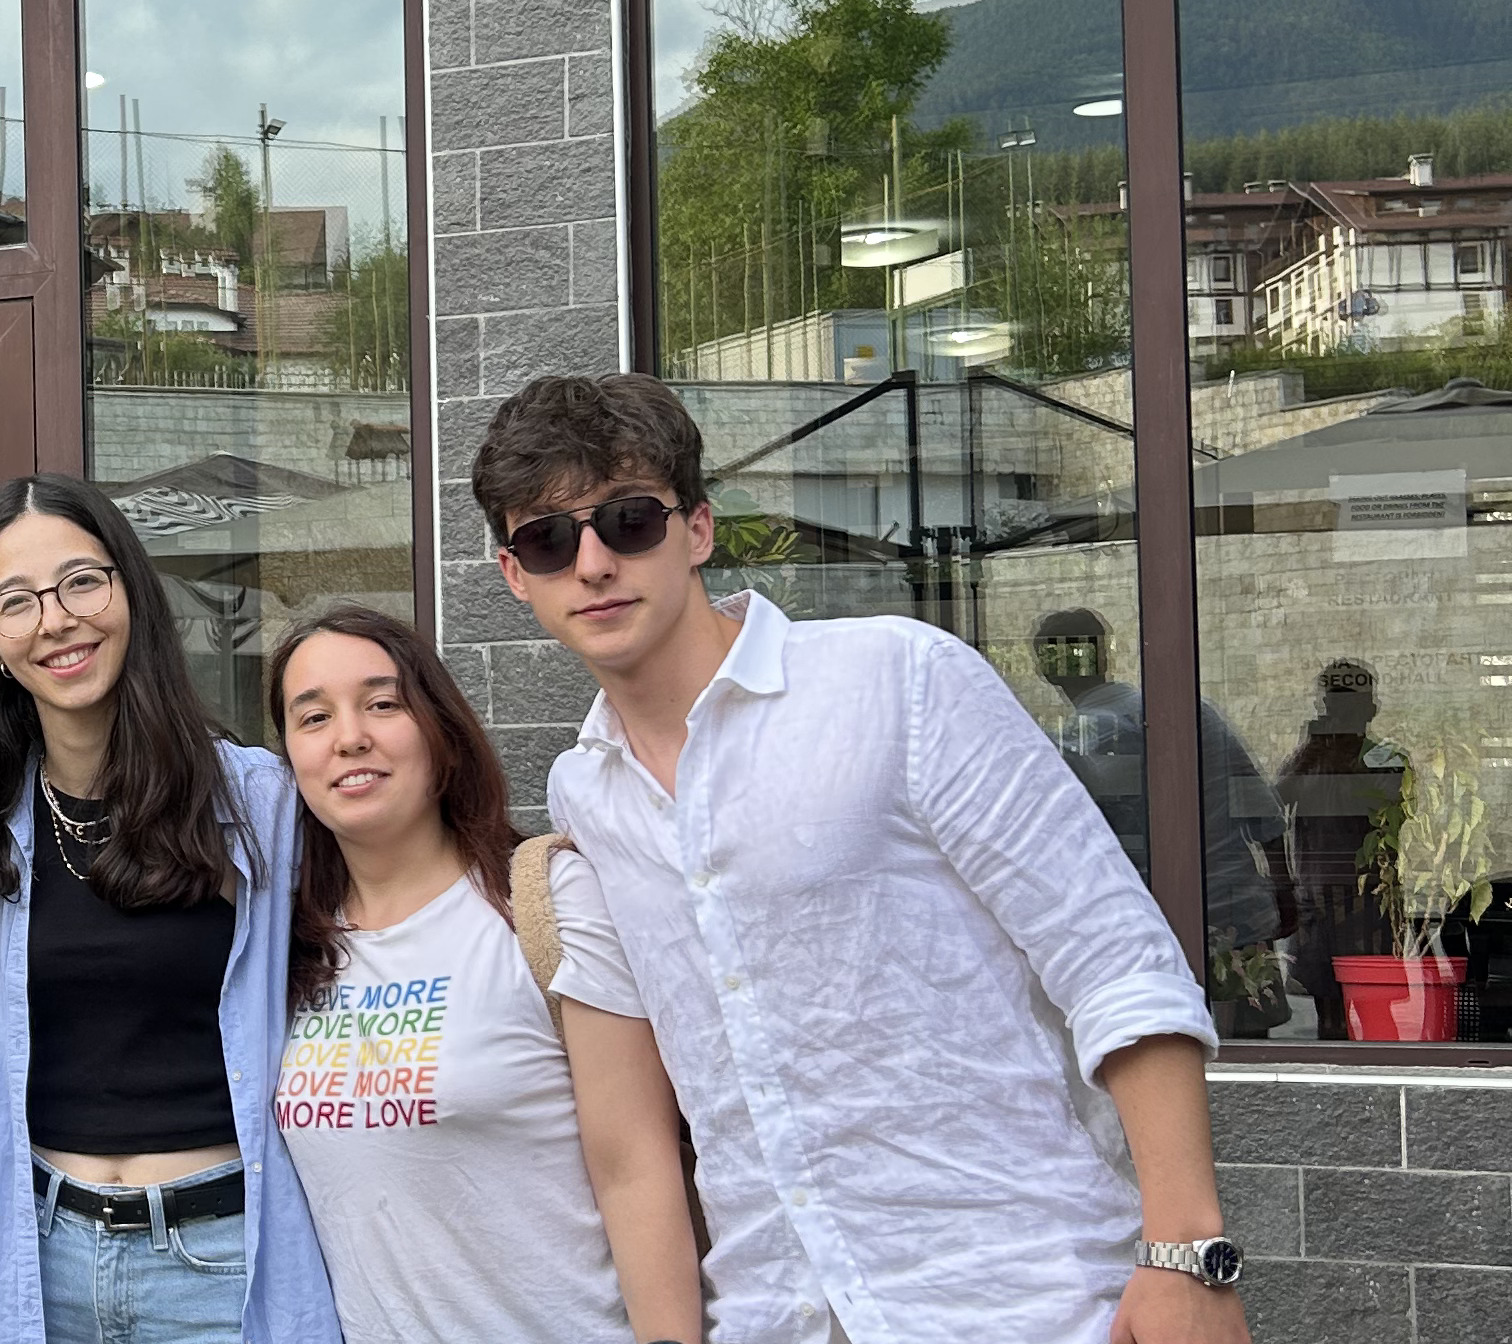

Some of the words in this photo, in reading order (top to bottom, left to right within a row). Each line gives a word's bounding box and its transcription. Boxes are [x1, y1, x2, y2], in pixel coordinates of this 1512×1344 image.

[357, 976, 451, 1010] MORE
[290, 1013, 352, 1040] LOVE
[358, 1005, 448, 1038] MORE
[283, 1042, 351, 1068] LOVE
[356, 1036, 443, 1066] MORE
[277, 1071, 348, 1097] LOVE
[352, 1066, 438, 1098] MORE
[277, 1101, 355, 1130] MORE
[365, 1099, 438, 1129] LOVE
